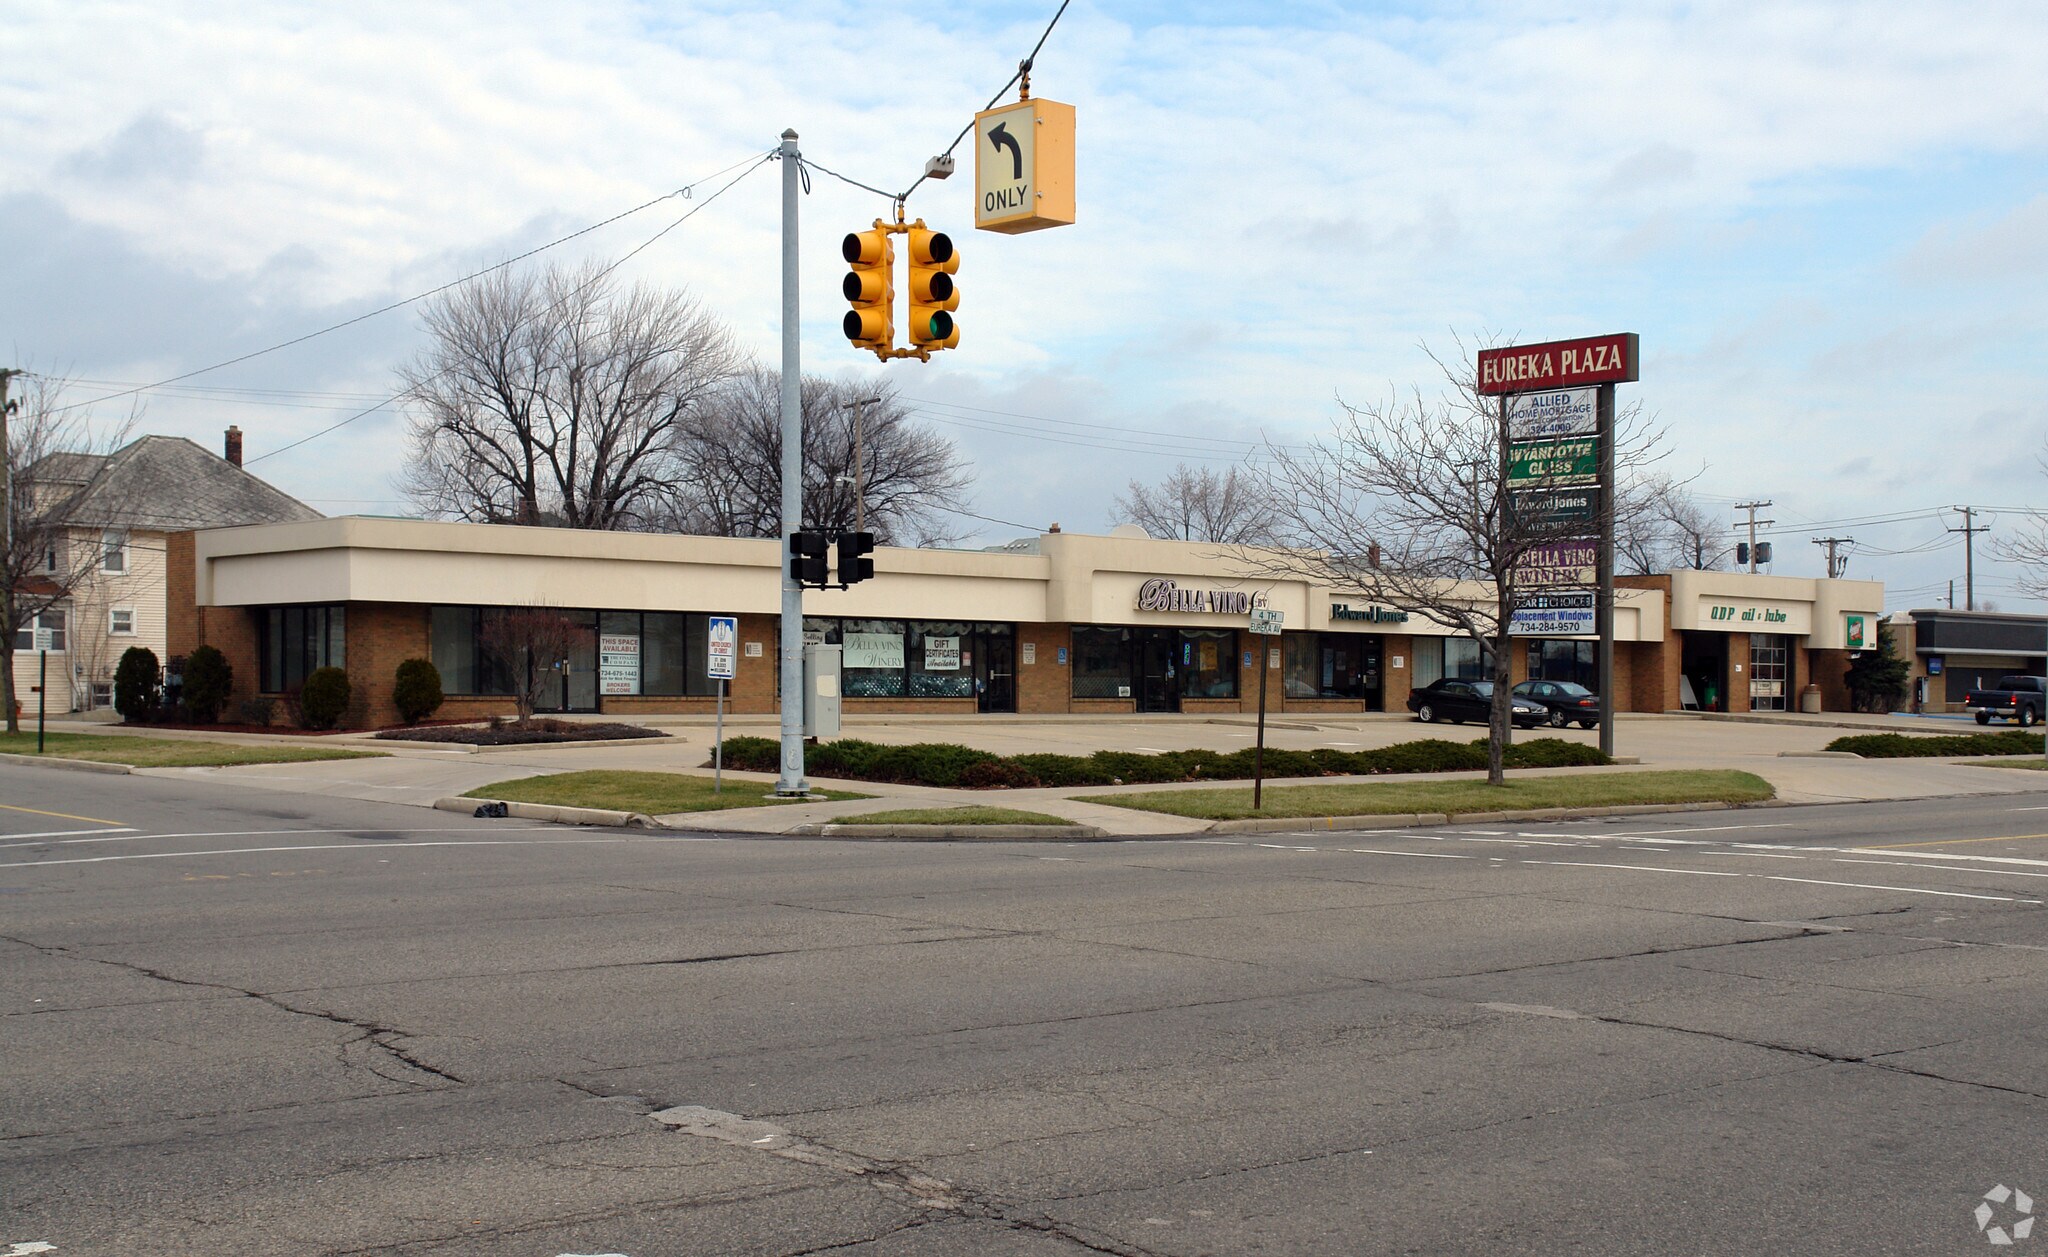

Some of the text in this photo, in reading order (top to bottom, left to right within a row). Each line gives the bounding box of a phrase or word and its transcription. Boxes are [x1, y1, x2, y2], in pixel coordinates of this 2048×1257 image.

[985, 184, 1027, 212] ONLY
[1483, 344, 1622, 384] EUREKA PLAZA
[1532, 394, 1570, 407] ALLIED
[1512, 403, 1591, 420] HOME MORTGAGE
[1564, 547, 1596, 565] VINO
[1139, 578, 1249, 614] BELLA VINO
[1258, 611, 1277, 620] 4 TH
[1331, 603, 1409, 623] Edward Jones
[1557, 610, 1592, 621] Windows
[1741, 607, 1756, 621] oil
[1764, 608, 1787, 623] lube
[1520, 621, 1580, 632] 734-284-9570
[934, 639, 950, 649] GIFT
[926, 648, 959, 659] CERTIFICATES
